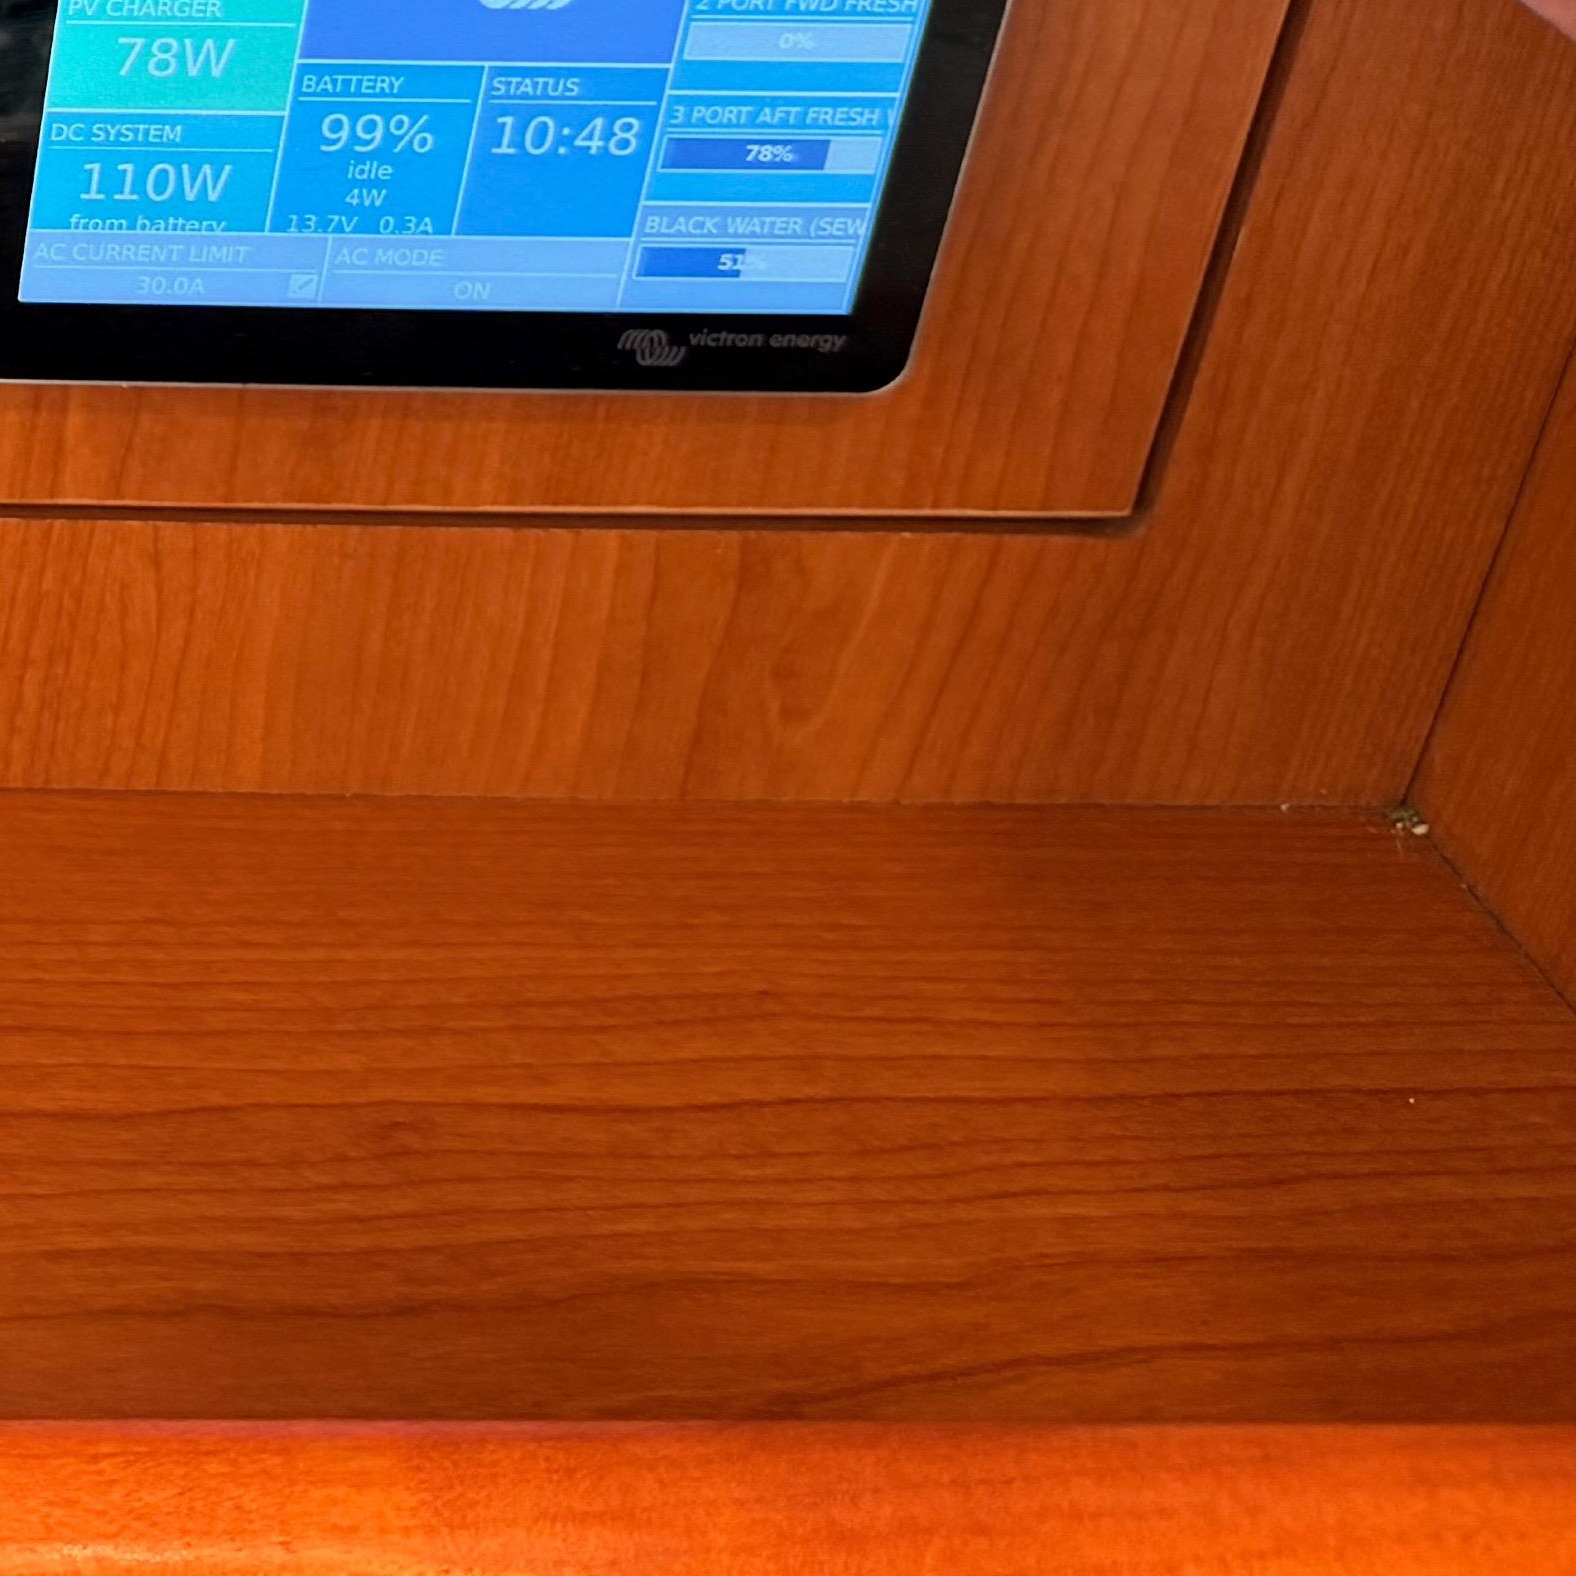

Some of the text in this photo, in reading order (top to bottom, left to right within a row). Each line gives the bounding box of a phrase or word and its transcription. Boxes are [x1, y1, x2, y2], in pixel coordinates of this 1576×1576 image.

[106, 0, 222, 18] CHARGER
[778, 32, 815, 50] 0%
[117, 37, 238, 78] 78W
[301, 75, 405, 94] BATTERY
[491, 78, 581, 96] STATUS
[669, 106, 684, 123] 3
[691, 106, 753, 124] PORT
[755, 107, 801, 125] AFT
[805, 107, 881, 126] FRESH
[51, 124, 183, 143] DC SYSTEM
[320, 114, 434, 153] 99%
[490, 116, 640, 157] 10:48
[745, 144, 794, 163] 78%
[347, 160, 393, 180] idle
[79, 162, 232, 202] 110W
[345, 188, 387, 207] 4W
[69, 214, 226, 232] from battery
[286, 215, 434, 234] 13.7V 0.3A
[644, 215, 721, 234] BLACK
[725, 216, 802, 235] WATER
[33, 243, 250, 264] AC CURRENT LIMIT
[335, 248, 444, 266] AC MODE
[136, 277, 206, 295] 30.0A
[454, 282, 491, 300] ON
[688, 329, 847, 352] victron energy
